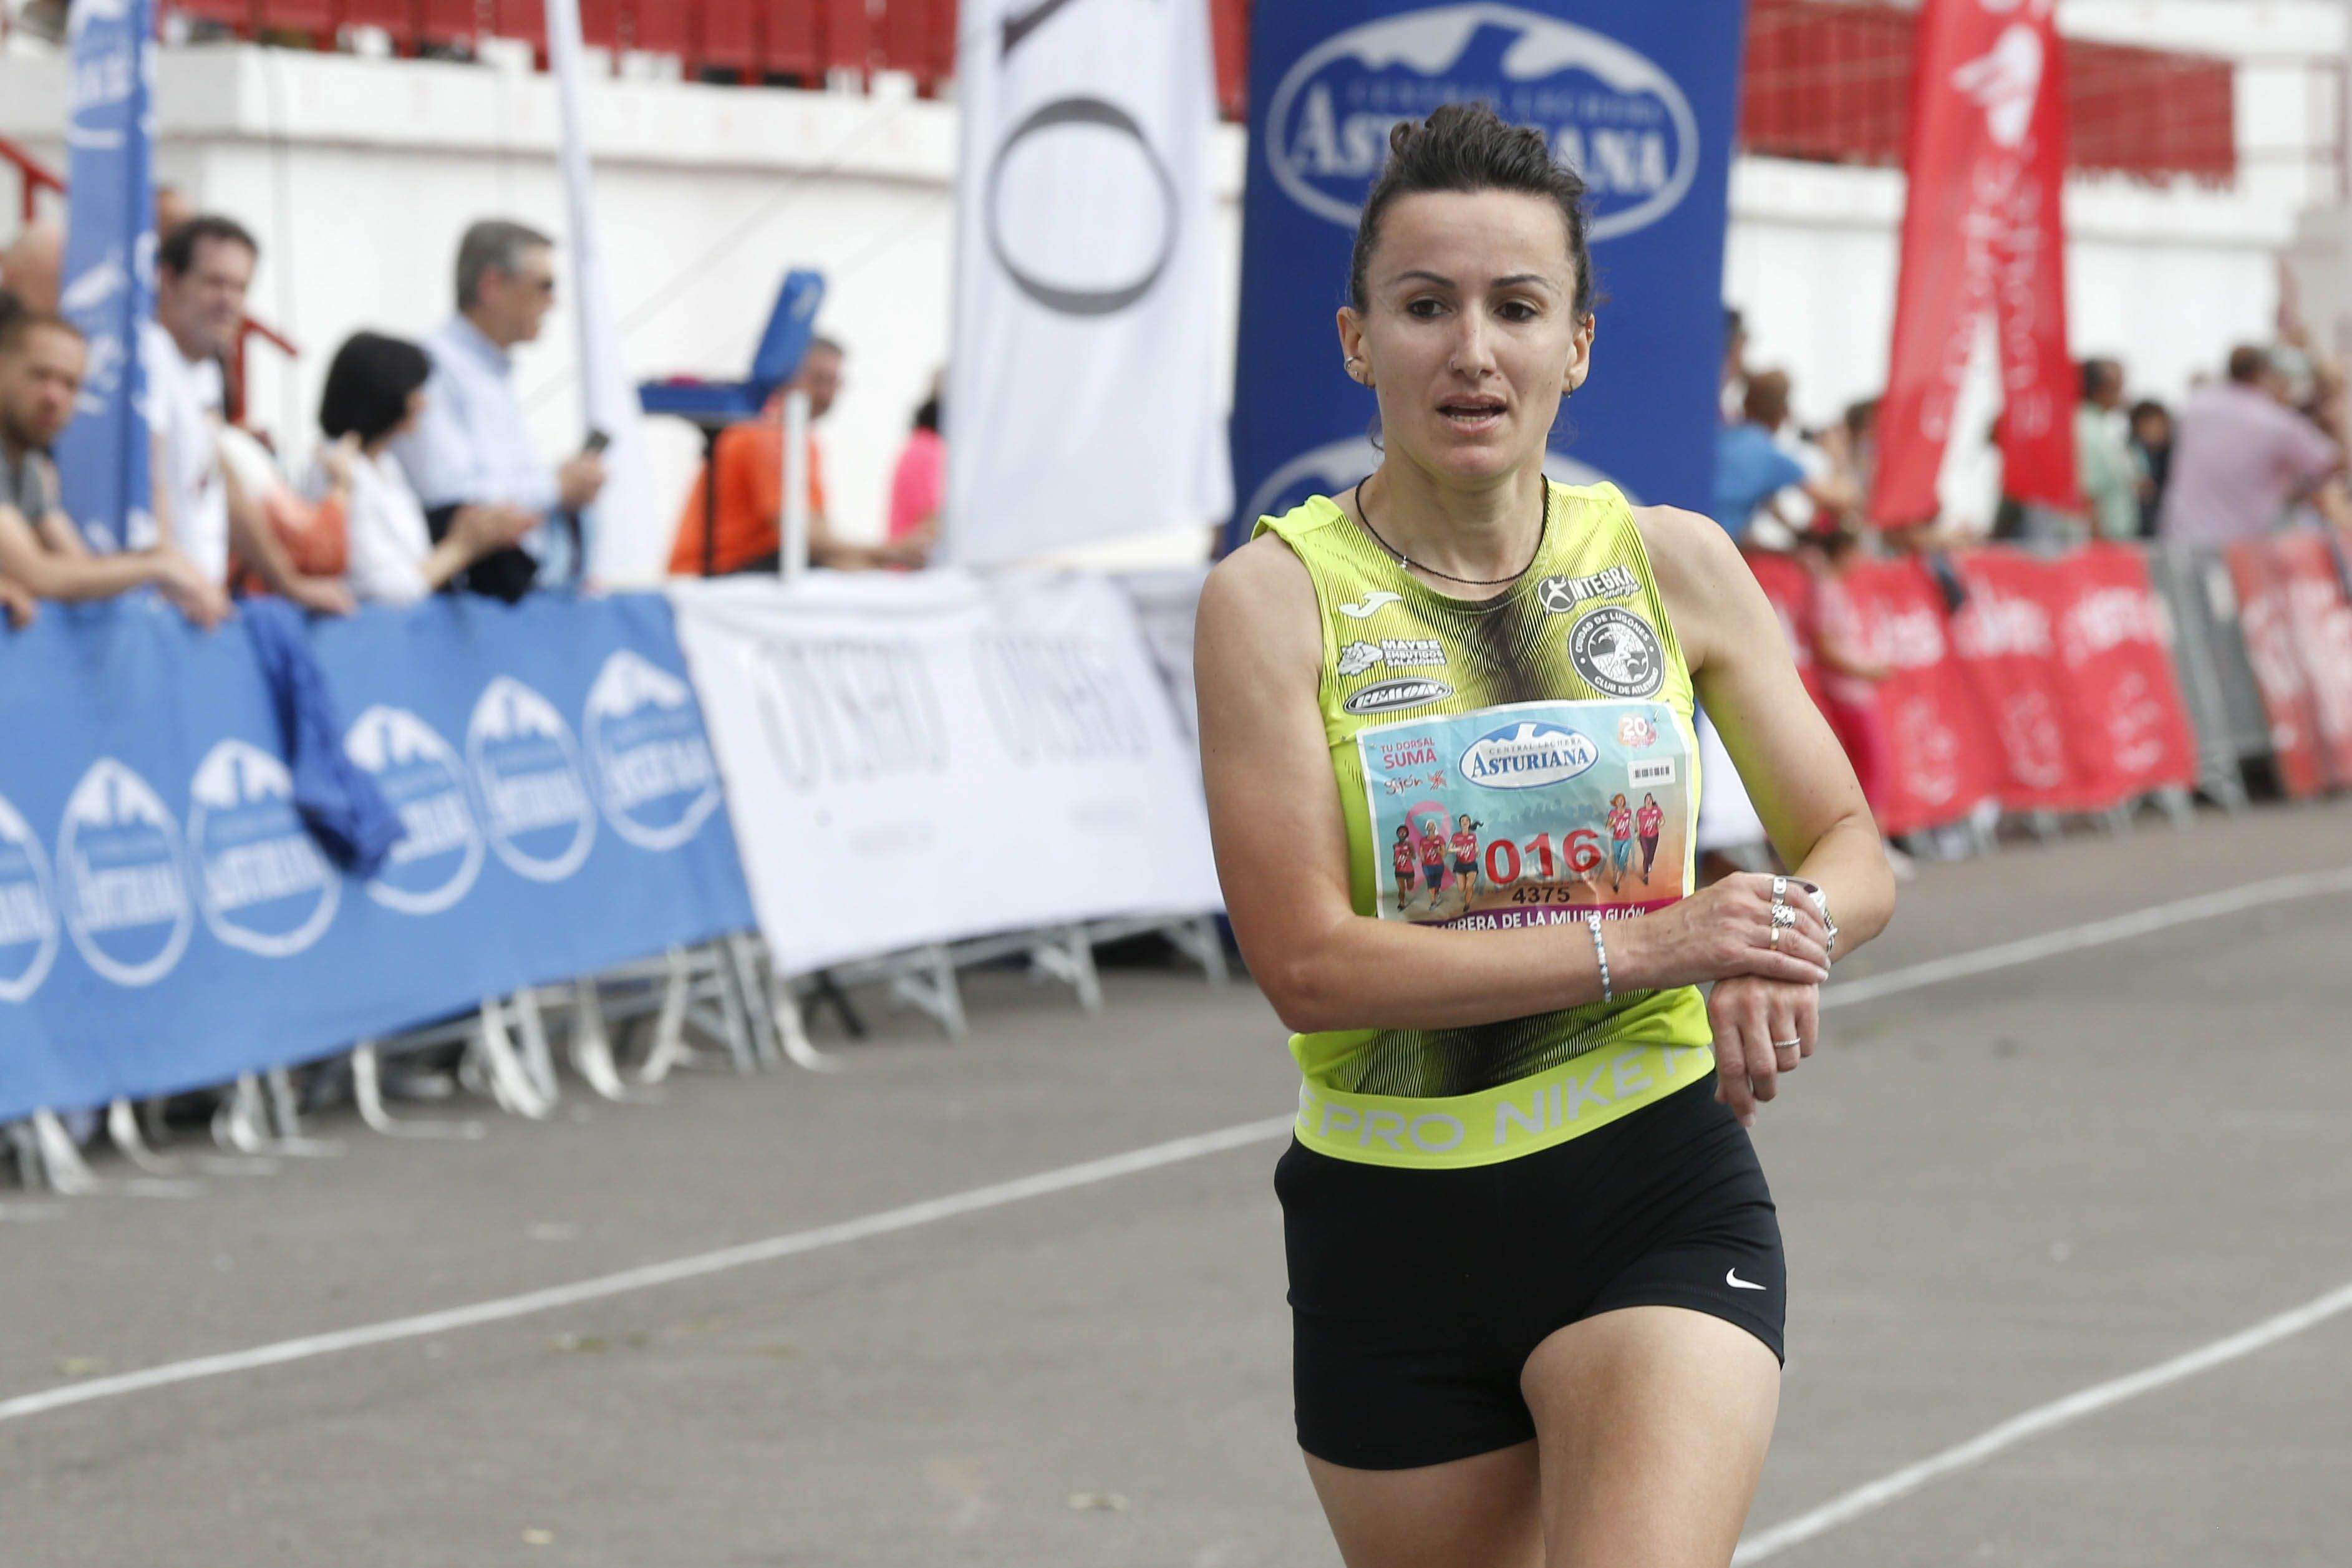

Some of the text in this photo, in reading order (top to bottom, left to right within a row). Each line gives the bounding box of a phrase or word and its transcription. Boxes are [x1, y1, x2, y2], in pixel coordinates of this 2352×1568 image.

[1567, 564, 1636, 601] INTEGRA
[1594, 613, 1607, 626] DE
[1609, 612, 1650, 642] LUGONES
[1382, 640, 1440, 649] MAYBE
[1385, 650, 1443, 659] EMBUTIDOS
[1594, 675, 1617, 692] CLUB
[1618, 685, 1630, 694] DE
[1622, 717, 1648, 737] 20
[1381, 737, 1435, 754] TU DORSAL
[1489, 738, 1582, 755] CENTRAL LECHERA
[1383, 748, 1437, 770] SUMA
[1471, 748, 1589, 778] ASTURIANA
[1485, 829, 1601, 884] 016
[1512, 887, 1570, 903] 4375
[1502, 912, 1522, 929] DE
[1527, 910, 1546, 927] LA
[1317, 1103, 1464, 1153] PRO
[1494, 1044, 1652, 1146] NIKE
